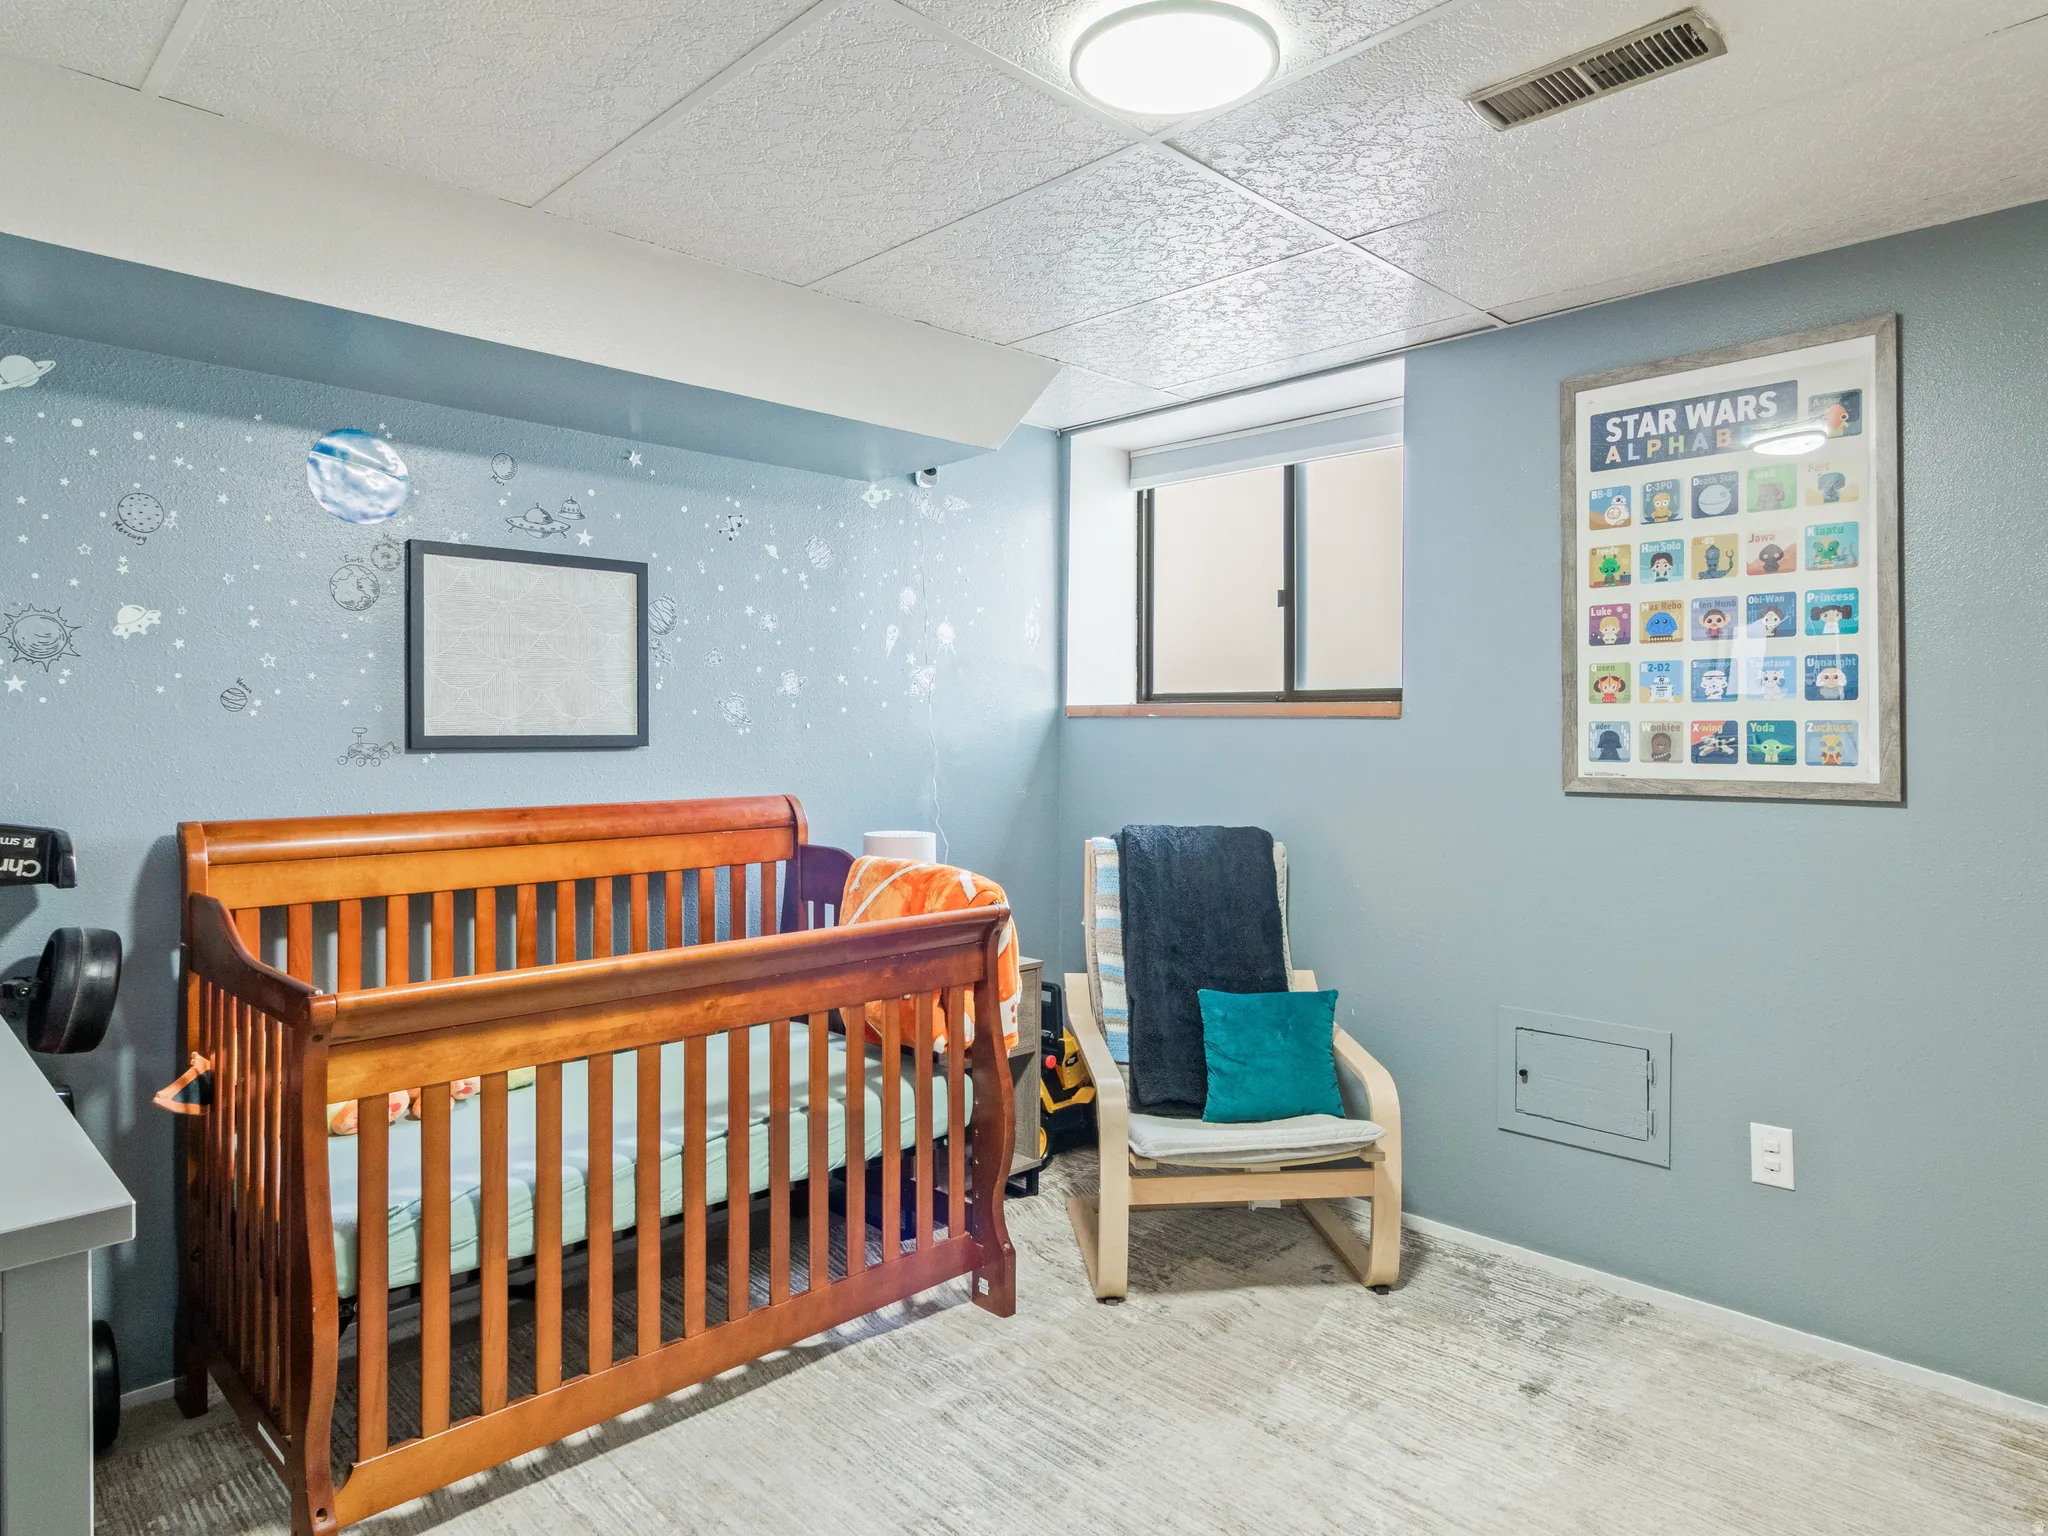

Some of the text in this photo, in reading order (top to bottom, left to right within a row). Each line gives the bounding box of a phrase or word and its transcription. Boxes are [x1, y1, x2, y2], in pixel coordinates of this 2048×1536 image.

[1606, 391, 1777, 442] STAR WARS
[1692, 474, 1738, 486] Death Star
[1591, 488, 1613, 500] BB-8
[112, 521, 147, 546] Mercury
[1807, 525, 1844, 537] Klaatu
[383, 533, 400, 546] Moon
[1748, 533, 1776, 543] Jawa
[1591, 546, 1619, 556] Greedo
[1641, 542, 1681, 554] Han Solo
[344, 554, 364, 564] Earth
[1748, 595, 1785, 605] Obi-Wan
[1807, 592, 1855, 603] Princess
[1641, 602, 1682, 612] Max Rebo
[1692, 599, 1737, 610] Nien Nunb
[1590, 607, 1612, 617] Luke
[1590, 663, 1615, 673] Queen
[1641, 662, 1671, 673] R2-D2
[1806, 657, 1857, 669] Ugnaught
[236, 677, 252, 693] Venus
[1590, 722, 1611, 731] Vader
[1641, 722, 1681, 732] Wookiee
[1692, 723, 1723, 734] X-wing
[1750, 722, 1775, 733] Yoda
[1806, 722, 1853, 733] Zuckuss
